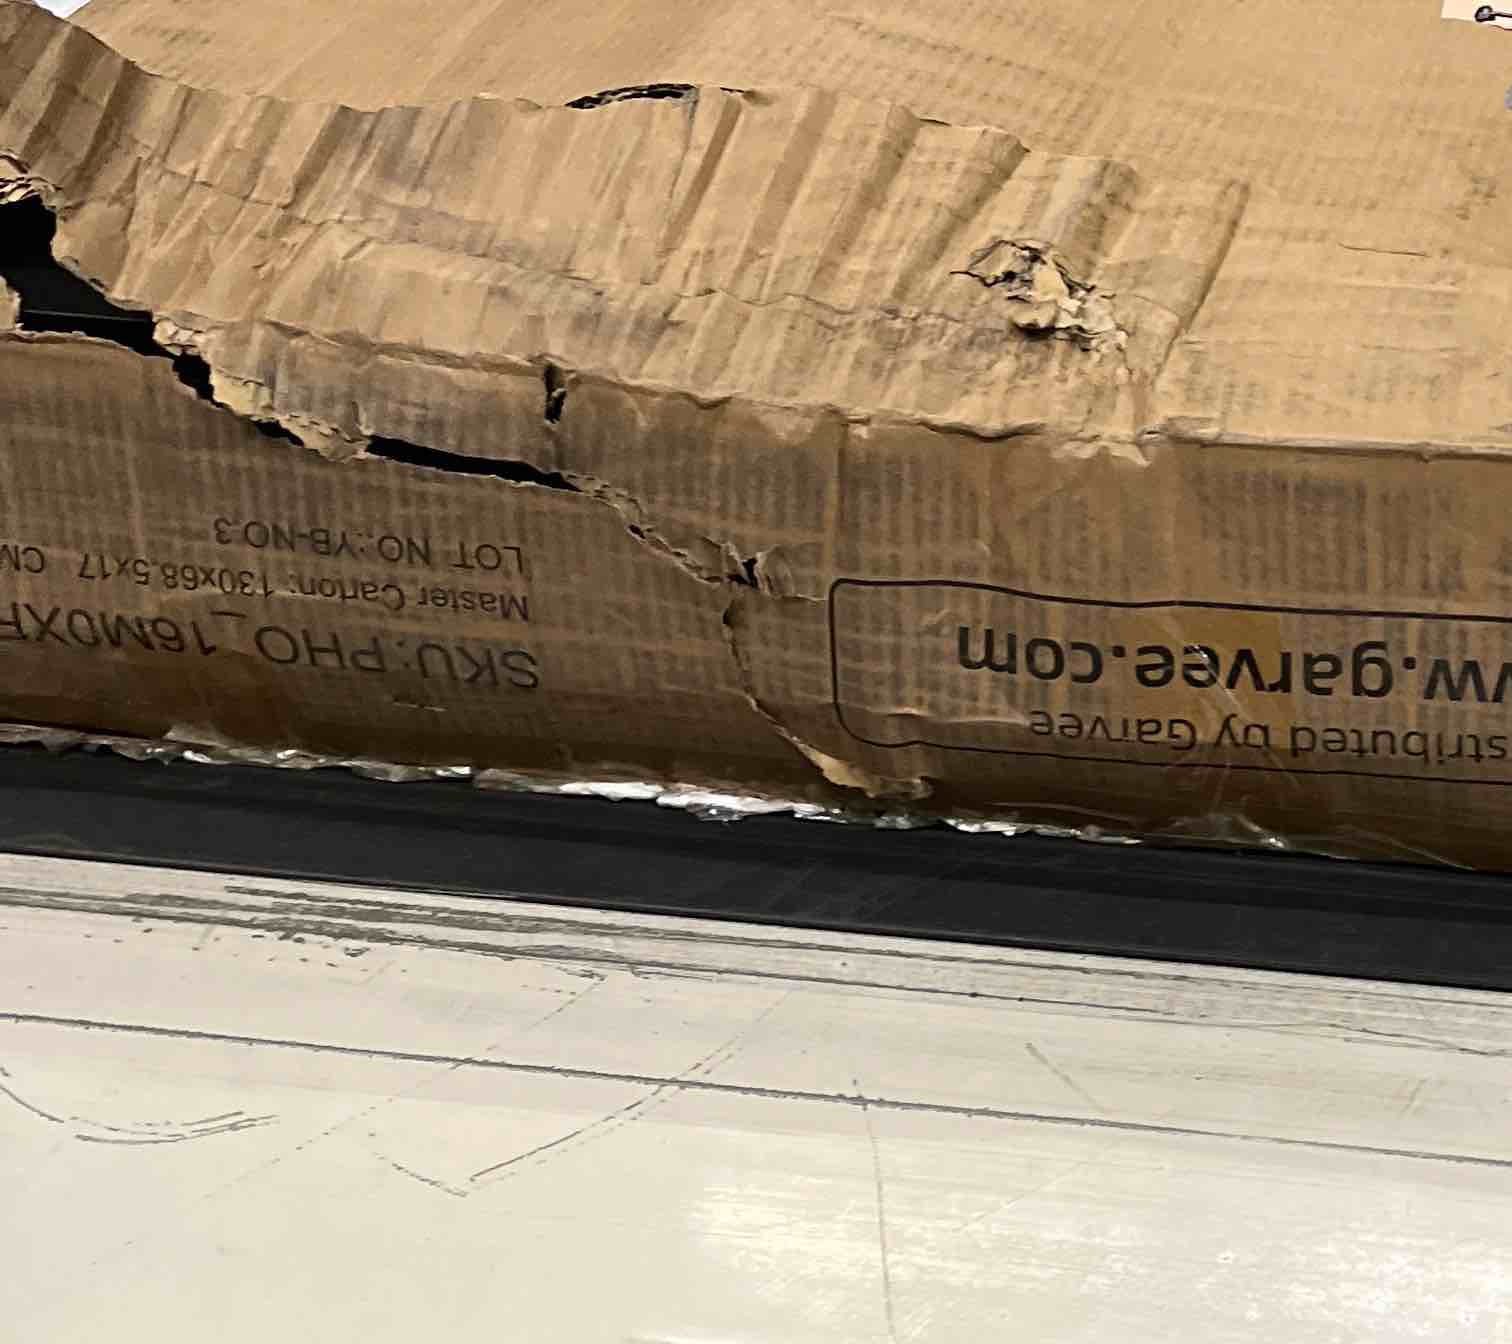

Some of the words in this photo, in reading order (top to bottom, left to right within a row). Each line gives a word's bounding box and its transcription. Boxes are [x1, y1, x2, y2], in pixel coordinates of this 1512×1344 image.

[76, 553, 273, 600] 130x68.5x17
[450, 542, 524, 573] LOT
[288, 578, 407, 612] Carton:
[417, 586, 529, 623] Master
[1030, 708, 1199, 752] Garvee
[1217, 709, 1272, 754] by
